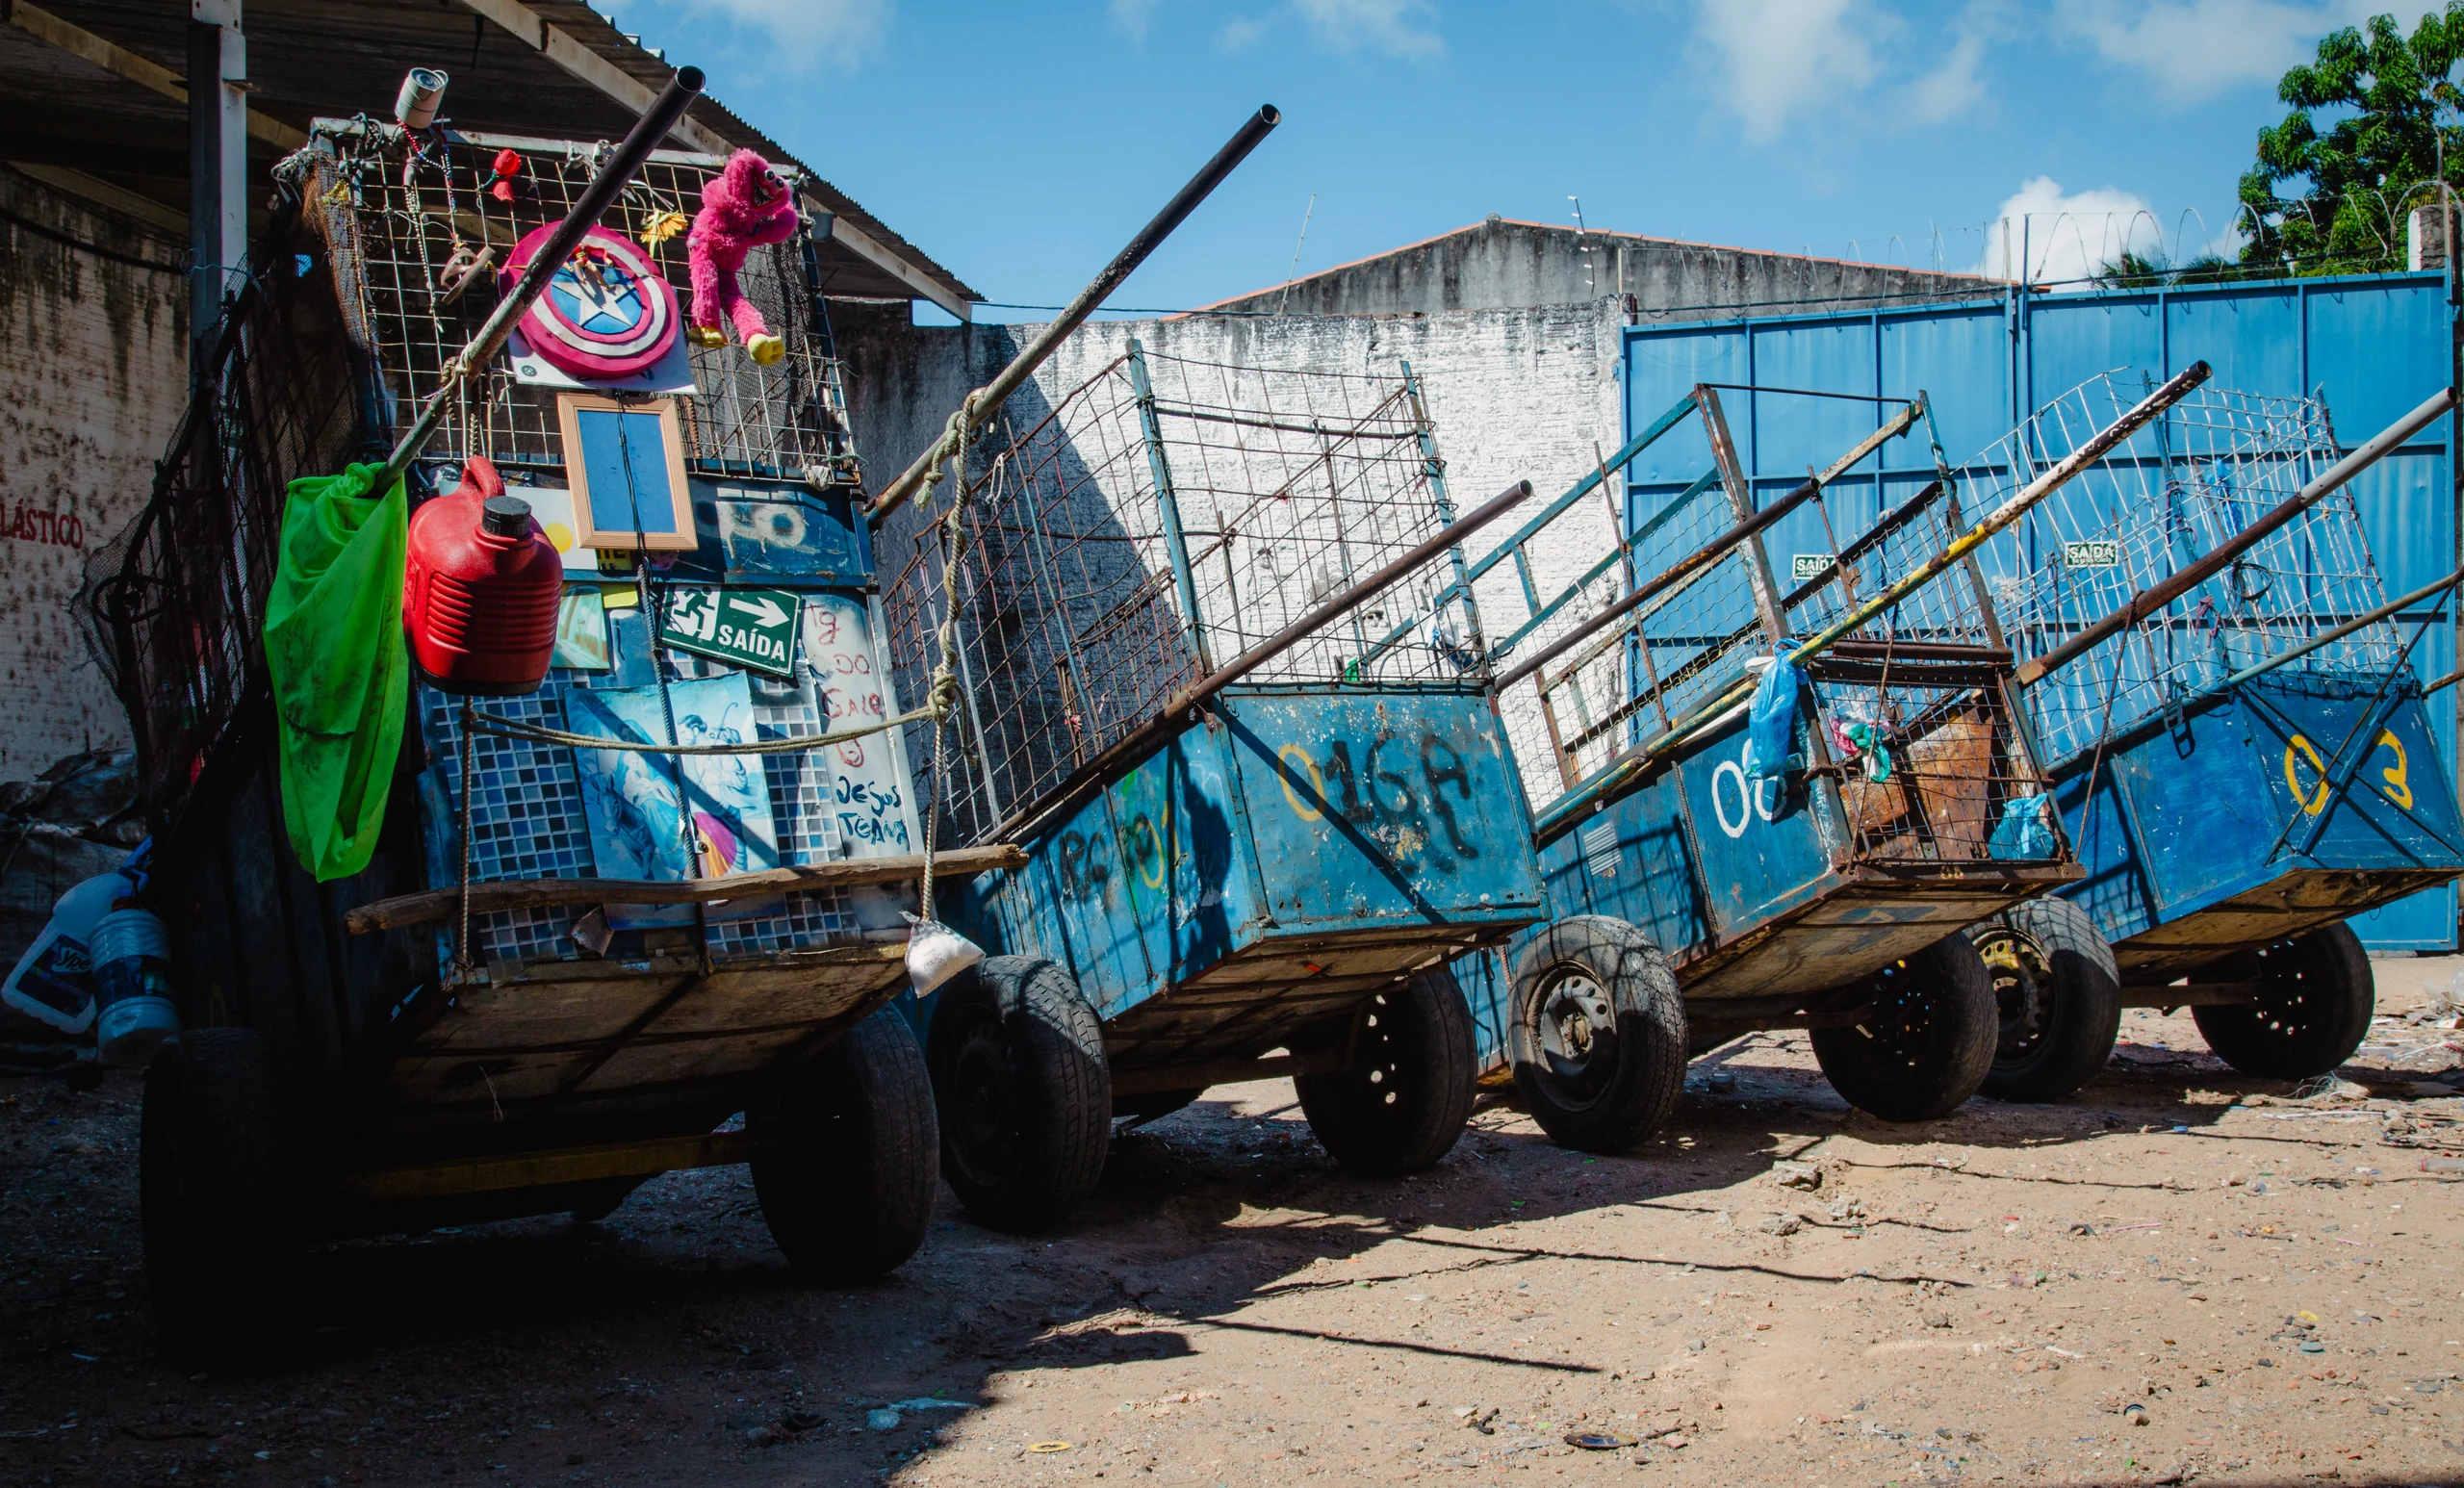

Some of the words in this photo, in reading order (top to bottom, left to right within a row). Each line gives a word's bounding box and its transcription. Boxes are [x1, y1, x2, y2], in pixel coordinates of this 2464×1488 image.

[718, 624, 785, 662] SAÍDA
[833, 654, 870, 675] DO
[2284, 728, 2413, 817] 03
